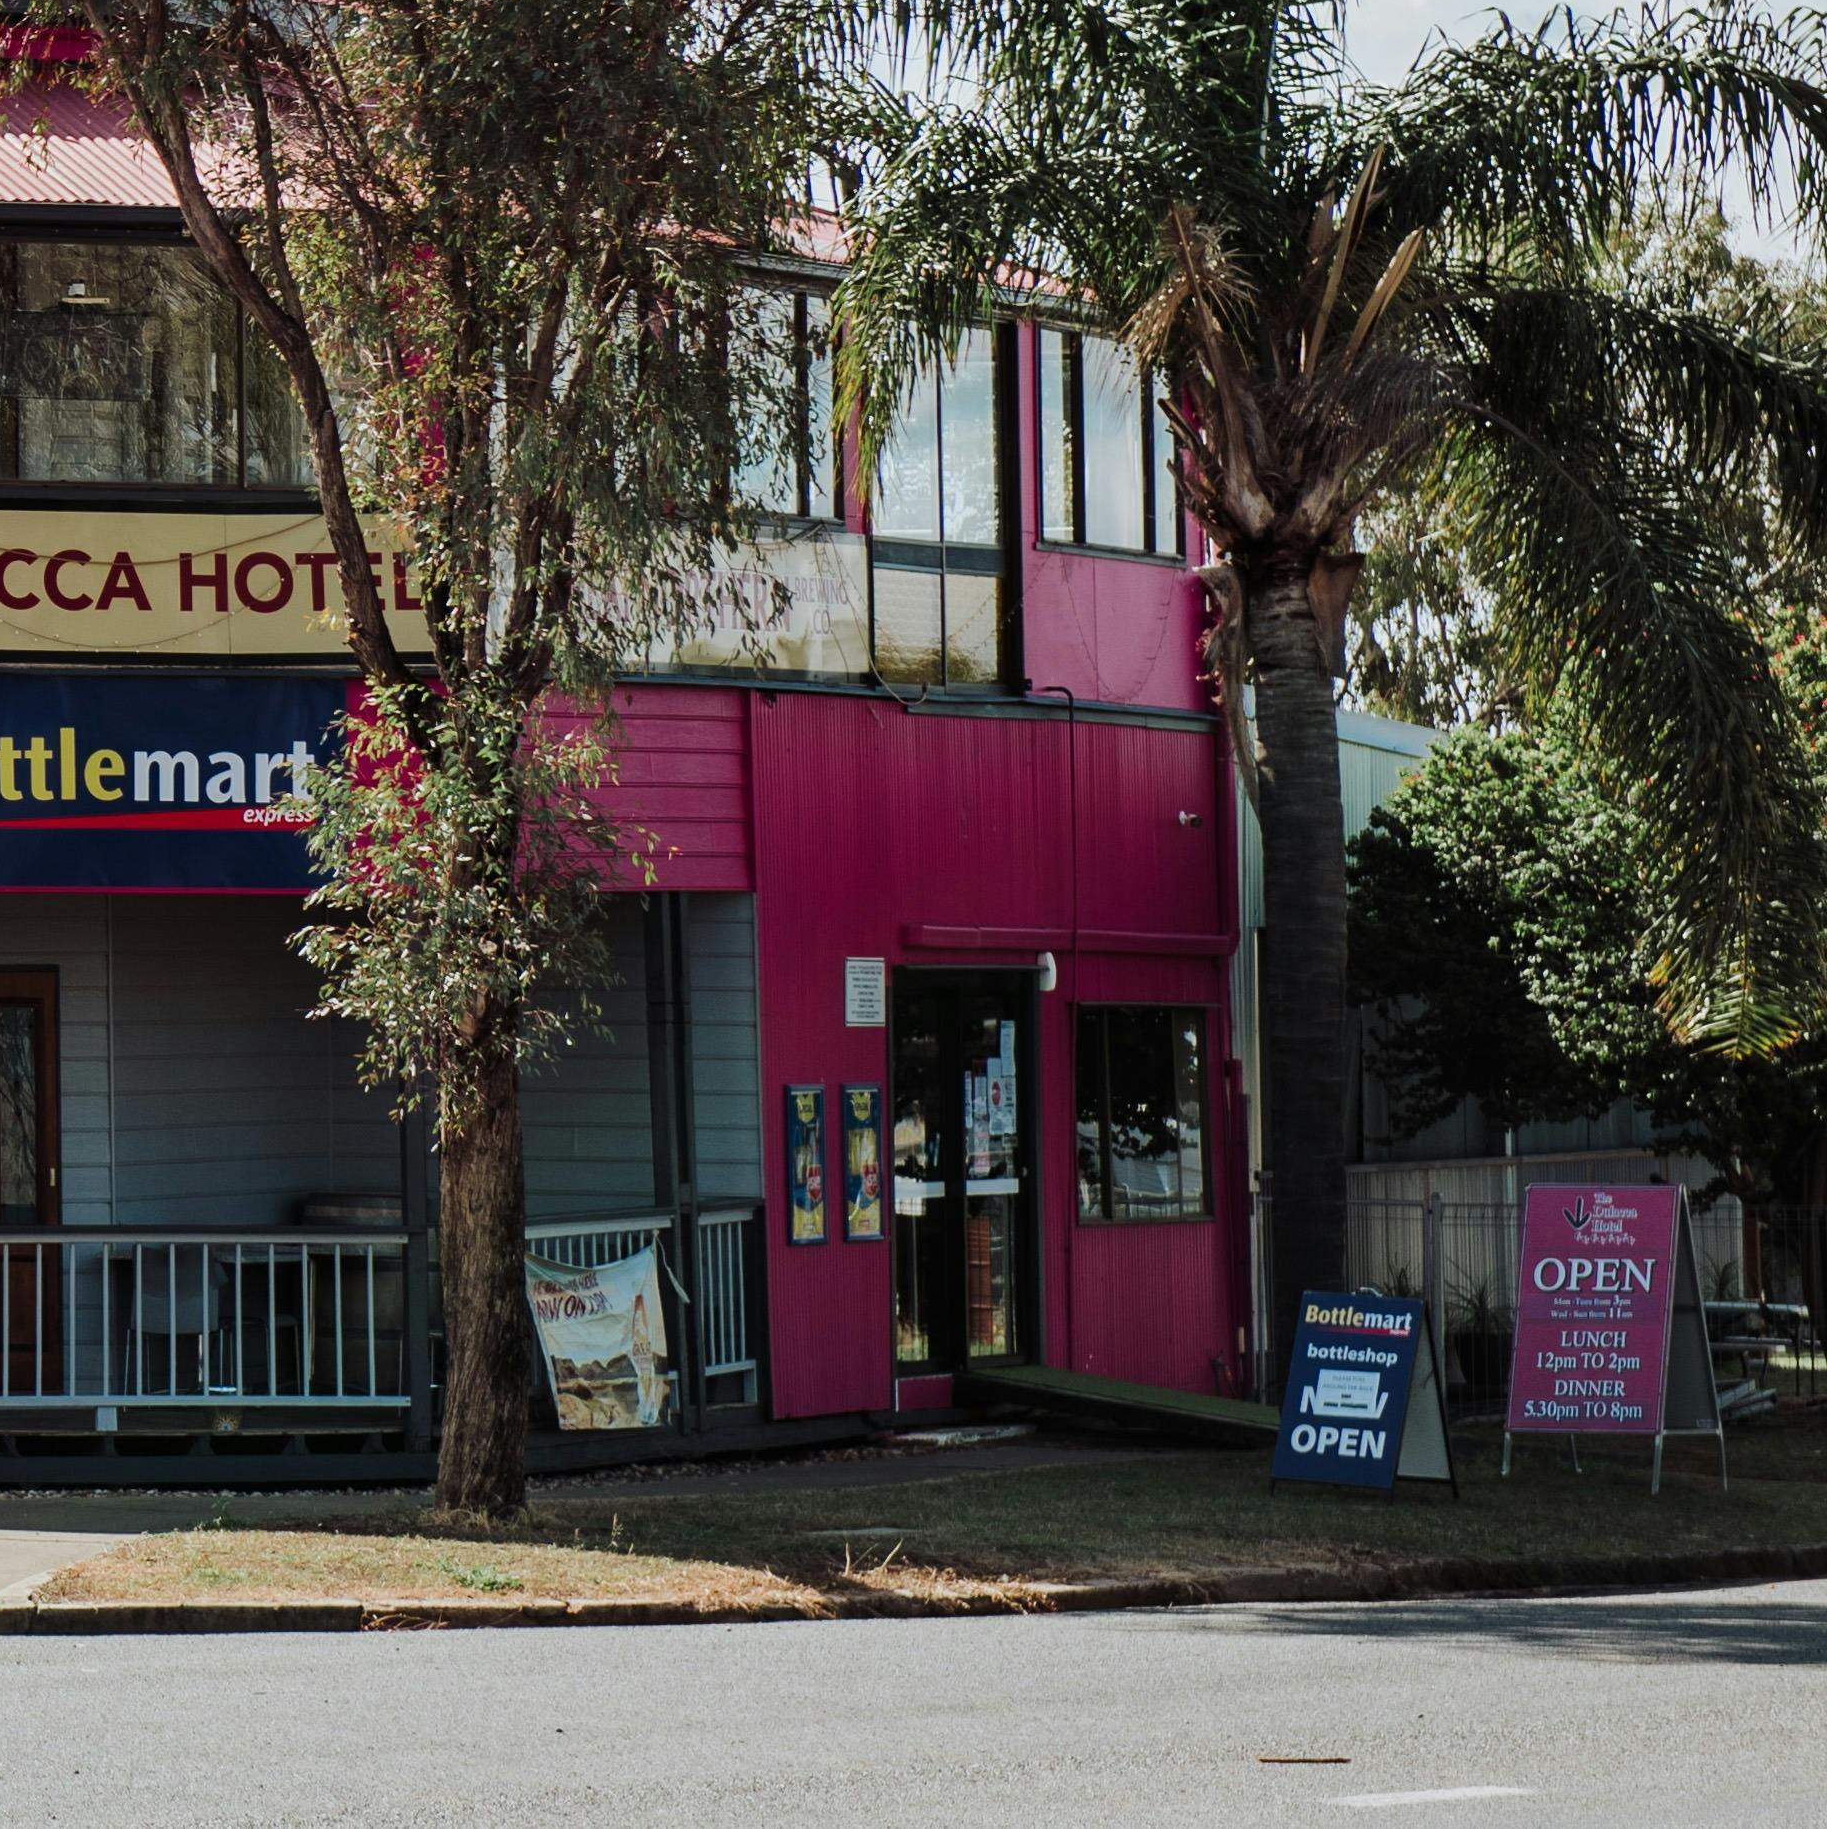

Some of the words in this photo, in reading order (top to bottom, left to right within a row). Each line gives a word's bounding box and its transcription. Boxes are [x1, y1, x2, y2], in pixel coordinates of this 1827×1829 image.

[796, 576, 848, 604] BREWING
[243, 808, 316, 827] express
[1533, 1257, 1657, 1293] OPEN
[1305, 1304, 1412, 1330] Bottlemart
[1561, 1331, 1627, 1348] LUNCH
[1307, 1341, 1398, 1367] bottleshop
[1536, 1351, 1577, 1373] 12pm
[1581, 1352, 1604, 1369] TO
[1609, 1352, 1640, 1374] 2pm
[1554, 1379, 1626, 1397] DINNER
[1524, 1400, 1579, 1422] 5.30pm
[1583, 1401, 1607, 1418] TO
[1610, 1401, 1643, 1423] 8pm
[1290, 1423, 1387, 1460] OPEN
